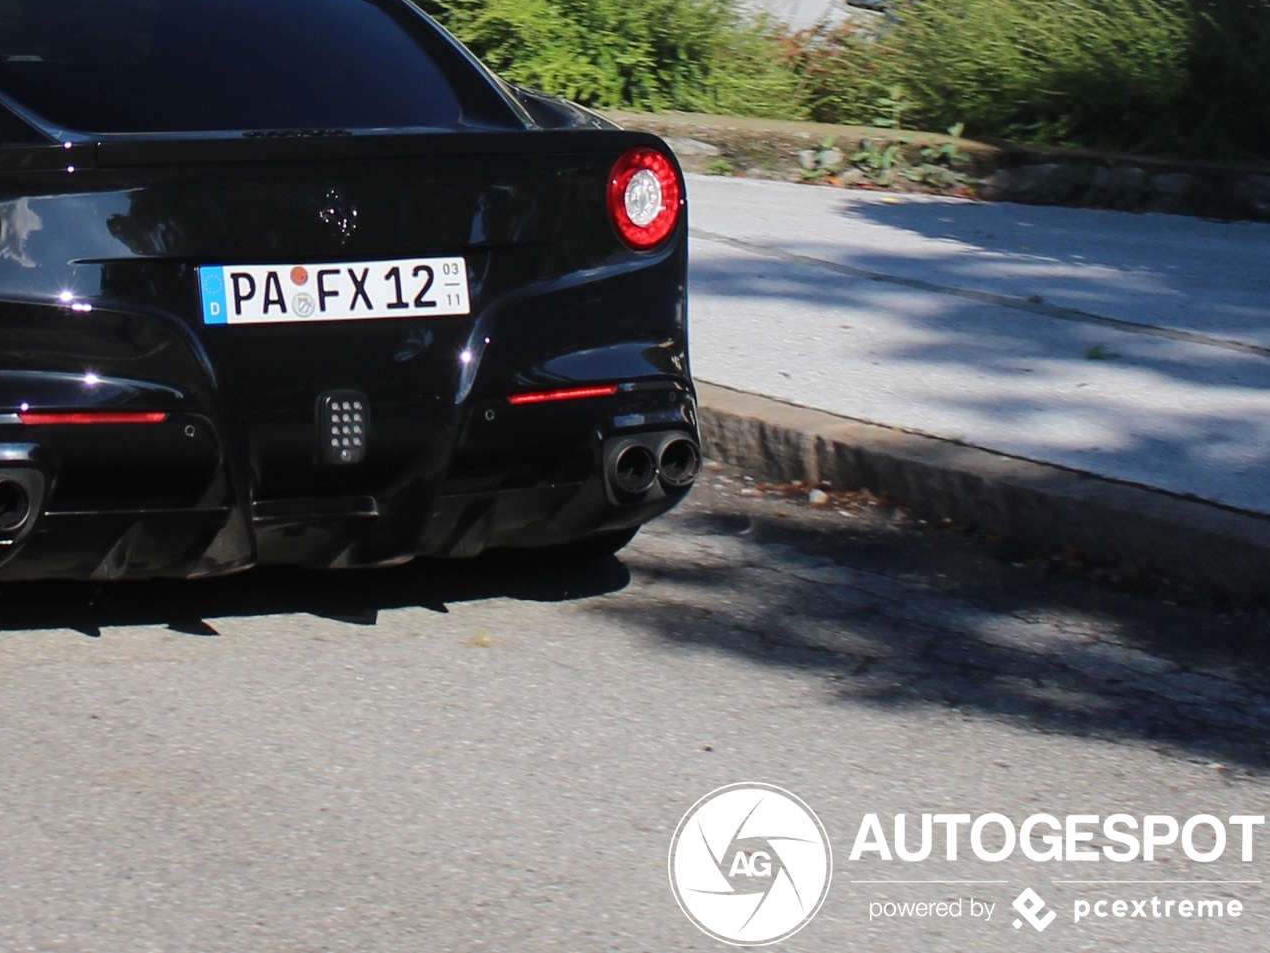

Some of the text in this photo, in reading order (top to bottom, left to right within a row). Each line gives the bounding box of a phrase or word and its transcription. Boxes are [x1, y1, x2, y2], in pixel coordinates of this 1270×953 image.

[443, 262, 460, 276] 03
[230, 270, 287, 316] PA
[446, 293, 462, 307] 11
[210, 302, 220, 316] D
